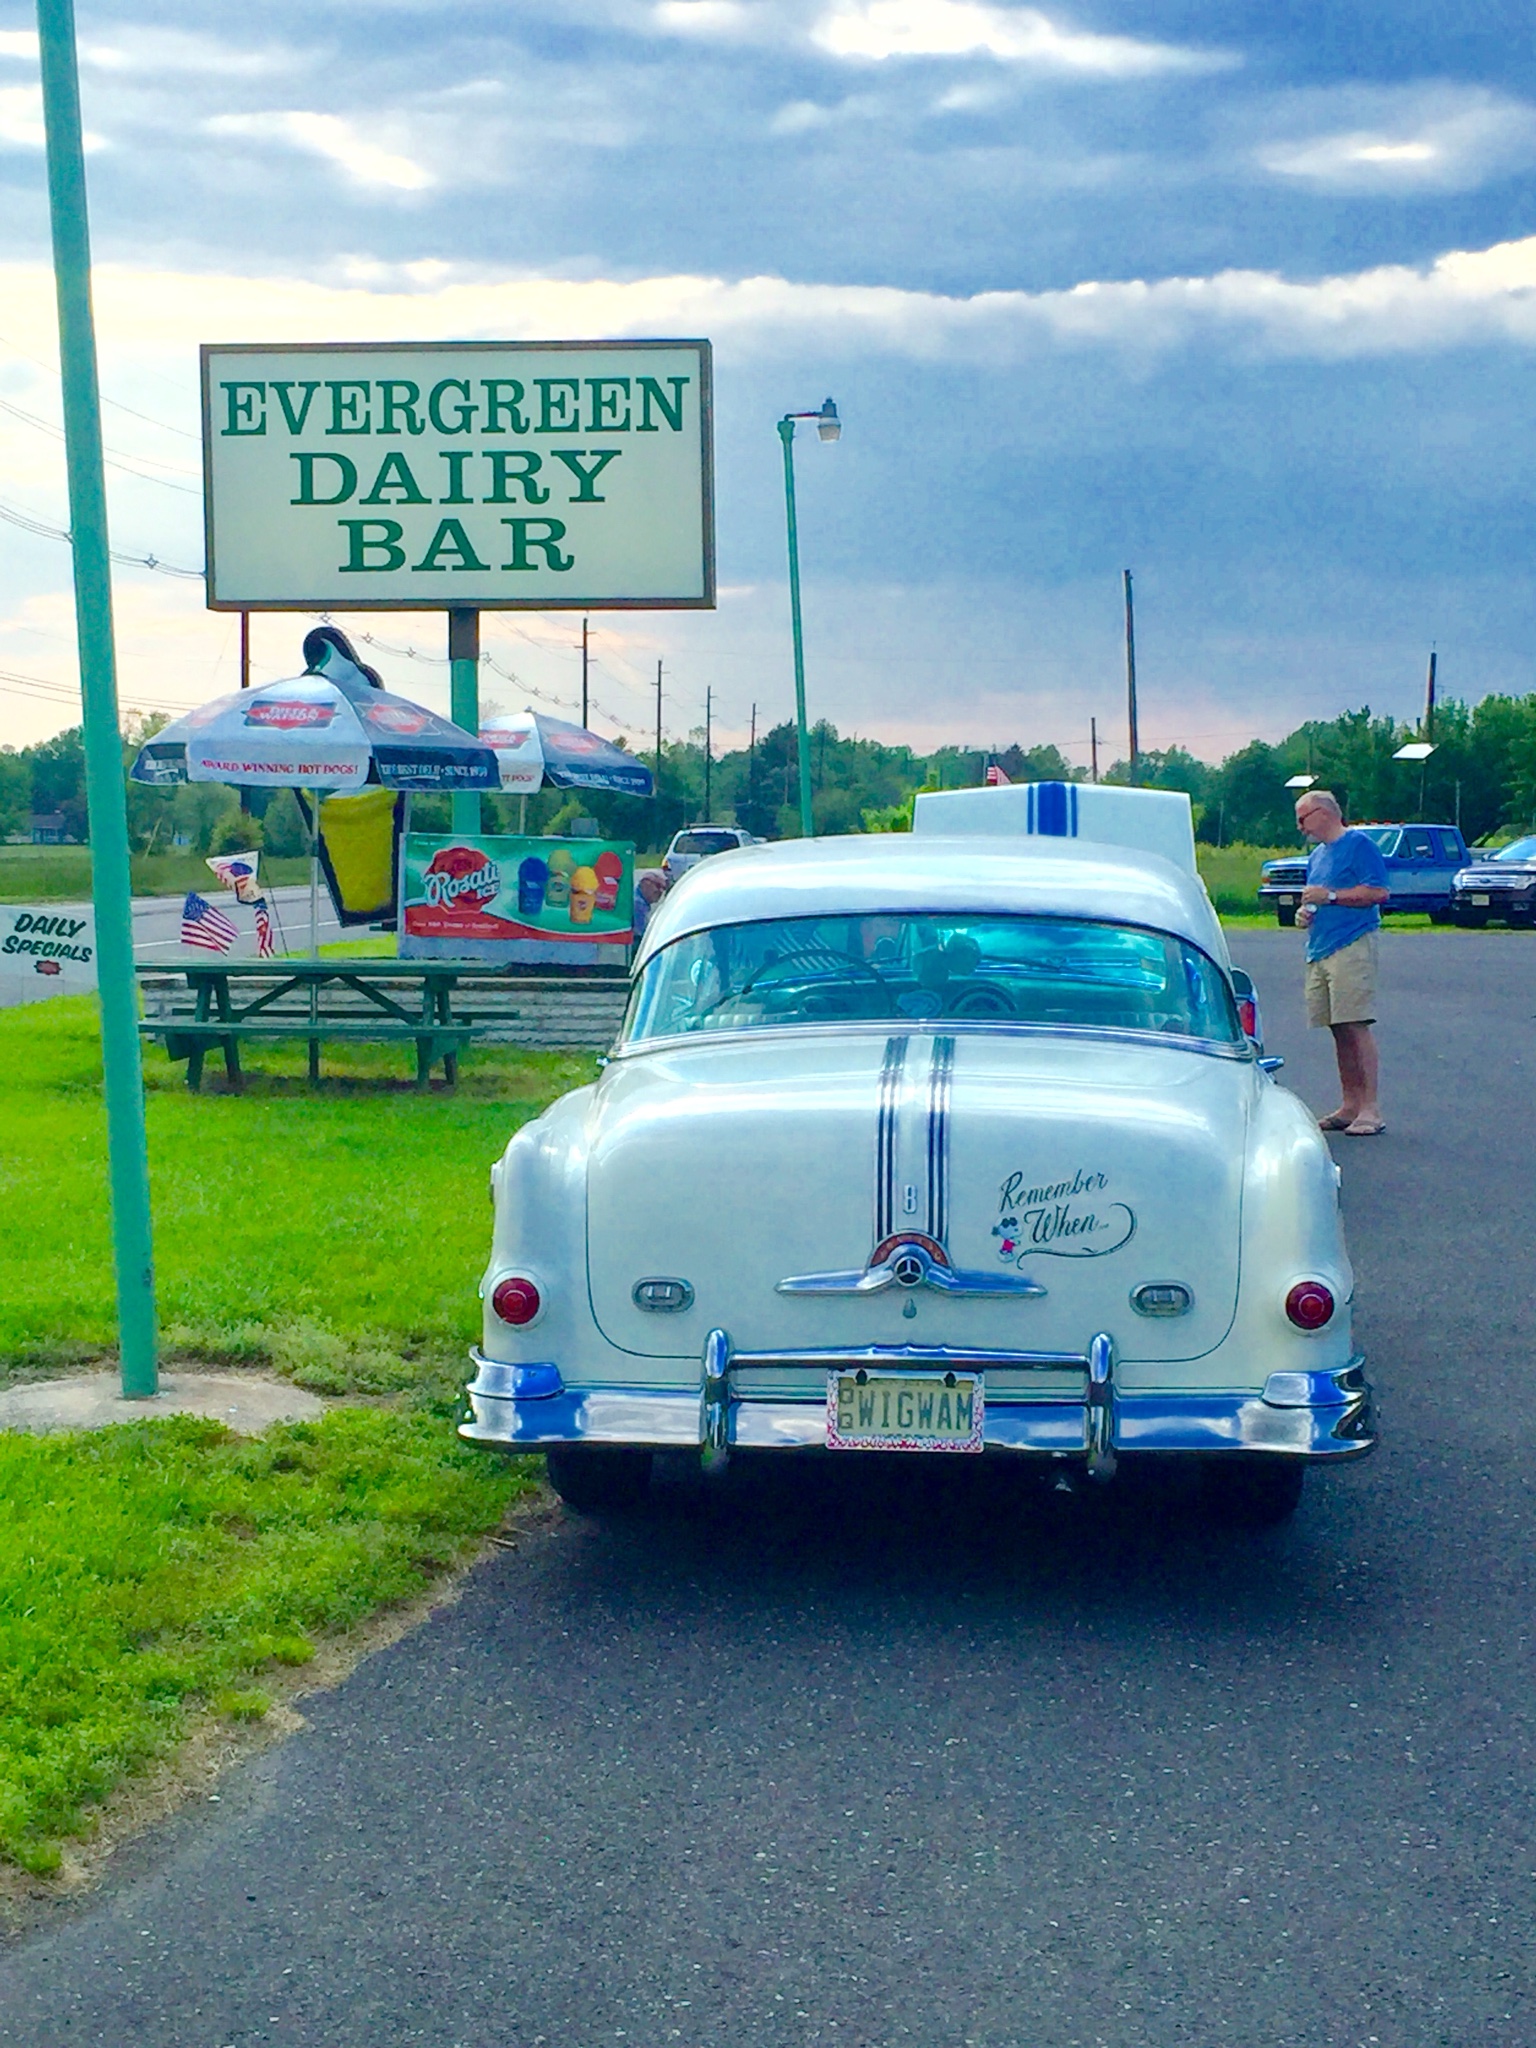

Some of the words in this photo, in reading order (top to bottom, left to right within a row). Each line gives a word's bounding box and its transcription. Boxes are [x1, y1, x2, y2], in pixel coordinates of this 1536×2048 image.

[220, 377, 691, 437] EVERGREEN
[290, 450, 623, 505] DAIRY
[338, 518, 576, 573] BAR
[242, 763, 294, 774] WINNING
[298, 764, 323, 775] HOT
[323, 764, 358, 775] DOGS!
[14, 913, 87, 938] DAILY
[1, 935, 93, 963] SPECIALS
[903, 1183, 917, 1214] 8
[999, 1168, 1109, 1213] Remember
[858, 1390, 973, 1430] WIGWAM
